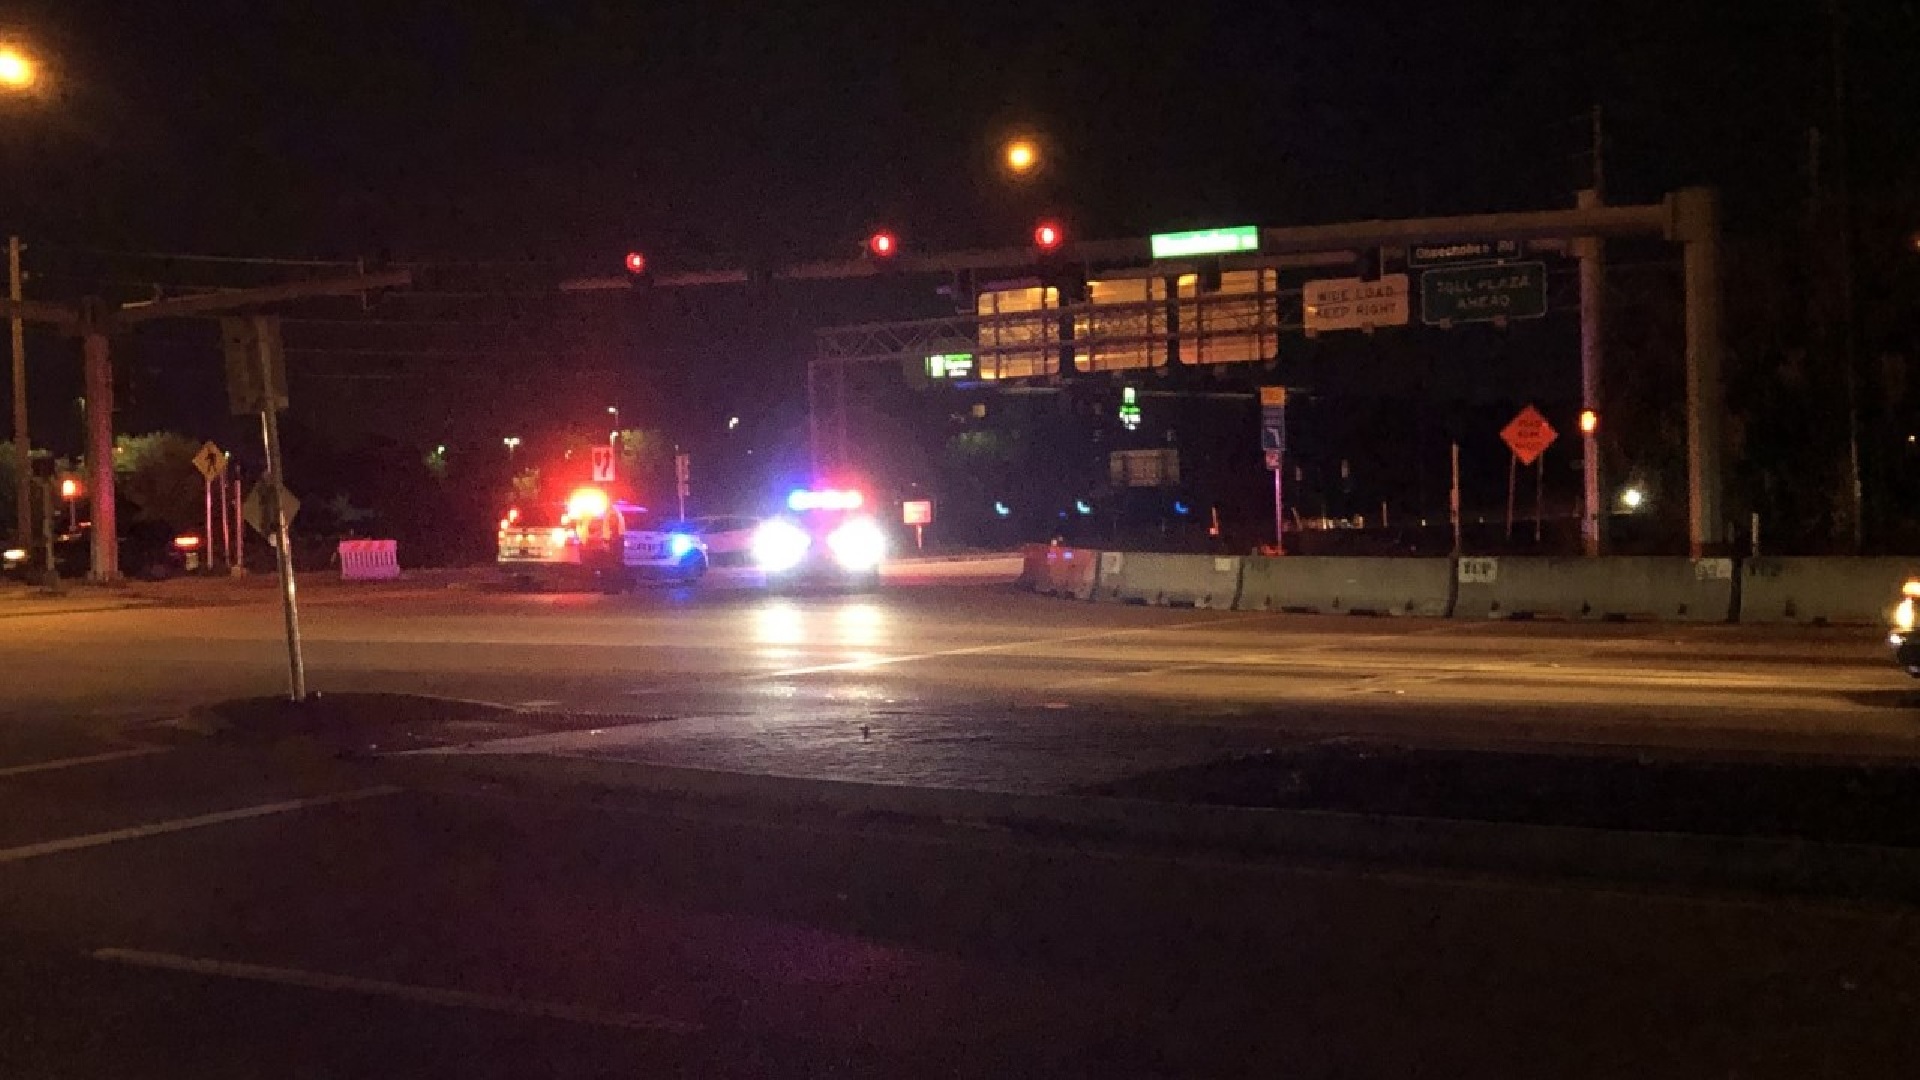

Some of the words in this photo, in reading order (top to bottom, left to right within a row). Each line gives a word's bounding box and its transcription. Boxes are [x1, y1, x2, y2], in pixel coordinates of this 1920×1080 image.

[1478, 275, 1530, 289] PLAZA
[1318, 289, 1349, 302] WIDE
[1356, 286, 1394, 299] LOAD
[1458, 294, 1510, 309] AHEAD
[1356, 303, 1397, 316] RIGHT
